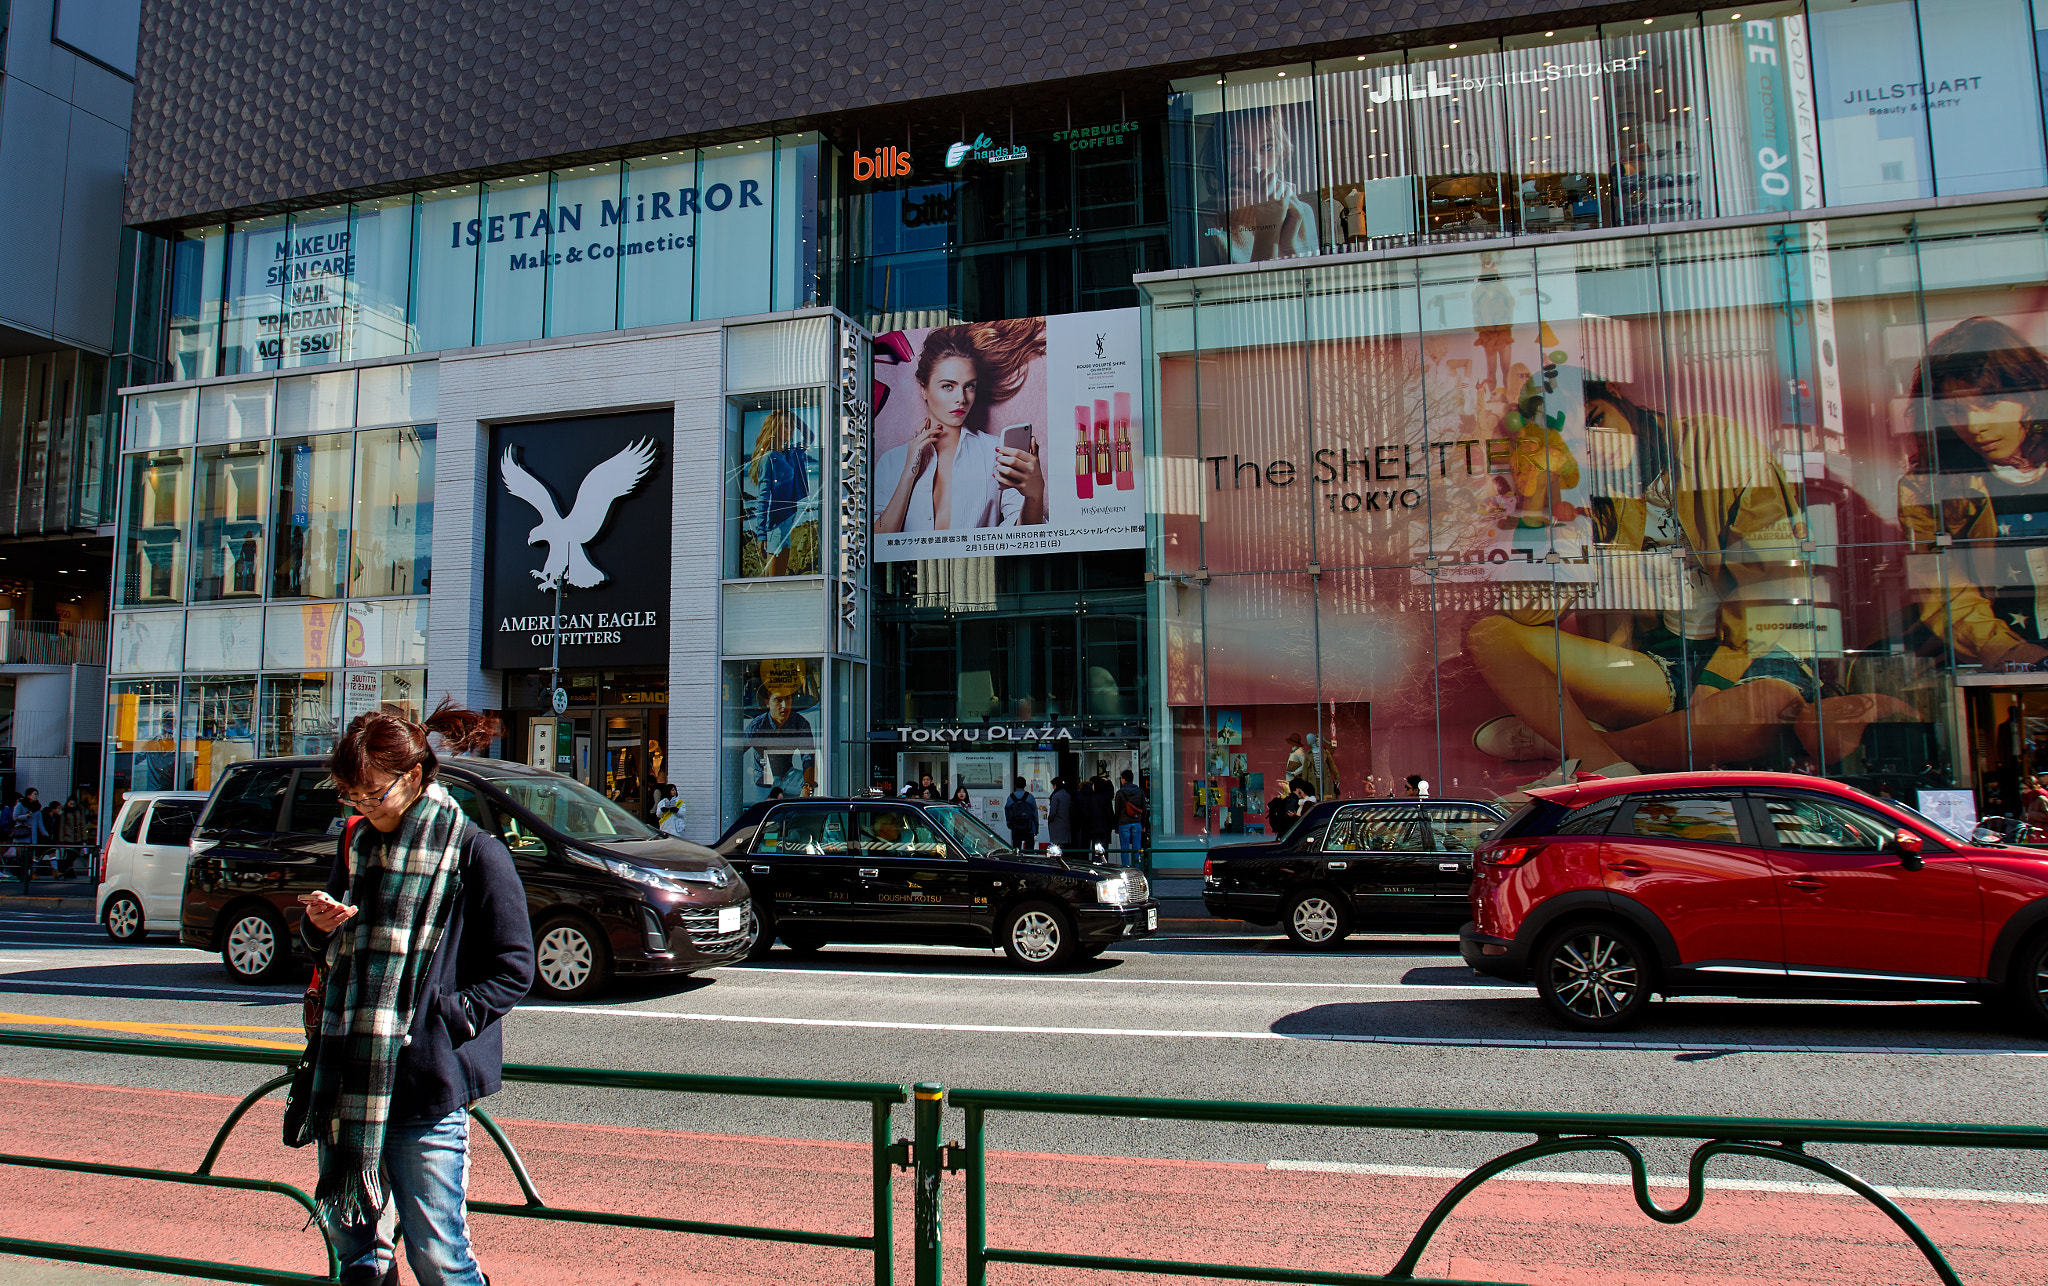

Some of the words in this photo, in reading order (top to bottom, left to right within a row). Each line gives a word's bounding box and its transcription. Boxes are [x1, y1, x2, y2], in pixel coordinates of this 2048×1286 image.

[1368, 70, 1452, 104] JILL
[1462, 76, 1487, 93] by
[1497, 56, 1642, 87] JILLSTUART
[1843, 76, 1982, 104] JILLSTUART
[1868, 104, 1907, 116] Beauty
[1910, 103, 1918, 112] &
[973, 132, 993, 151] be
[1052, 121, 1140, 143] STARBUCKS
[1069, 134, 1124, 151] COFFEE
[853, 145, 912, 181] bills
[974, 147, 1008, 160] hands
[1012, 145, 1027, 155] be
[451, 203, 583, 249] ISETAN
[275, 235, 325, 260] MAKE
[328, 232, 352, 251] UP
[509, 250, 562, 271] Make
[566, 246, 583, 263] &
[588, 233, 697, 261] Cosmetics
[266, 261, 308, 284] SKIN
[310, 254, 356, 278] CARE
[292, 284, 329, 306] NAIL
[257, 303, 360, 334] FRAGRANCE
[256, 329, 358, 359] ACCESSORY
[1206, 453, 1297, 491] The
[857, 400, 868, 570] OUTFITTERS
[1325, 488, 1422, 514] TOKYO
[973, 533, 1004, 542] ISETAN
[498, 613, 594, 633] AMERICAN
[597, 611, 657, 629] EAGLE
[531, 630, 622, 647] OUFITTERS
[897, 727, 981, 742] TOKYU
[988, 725, 1073, 741] PLAZA
[828, 891, 849, 900] TAXI
[878, 893, 913, 903] DOUSHIN
[914, 895, 942, 903] KOTSU
